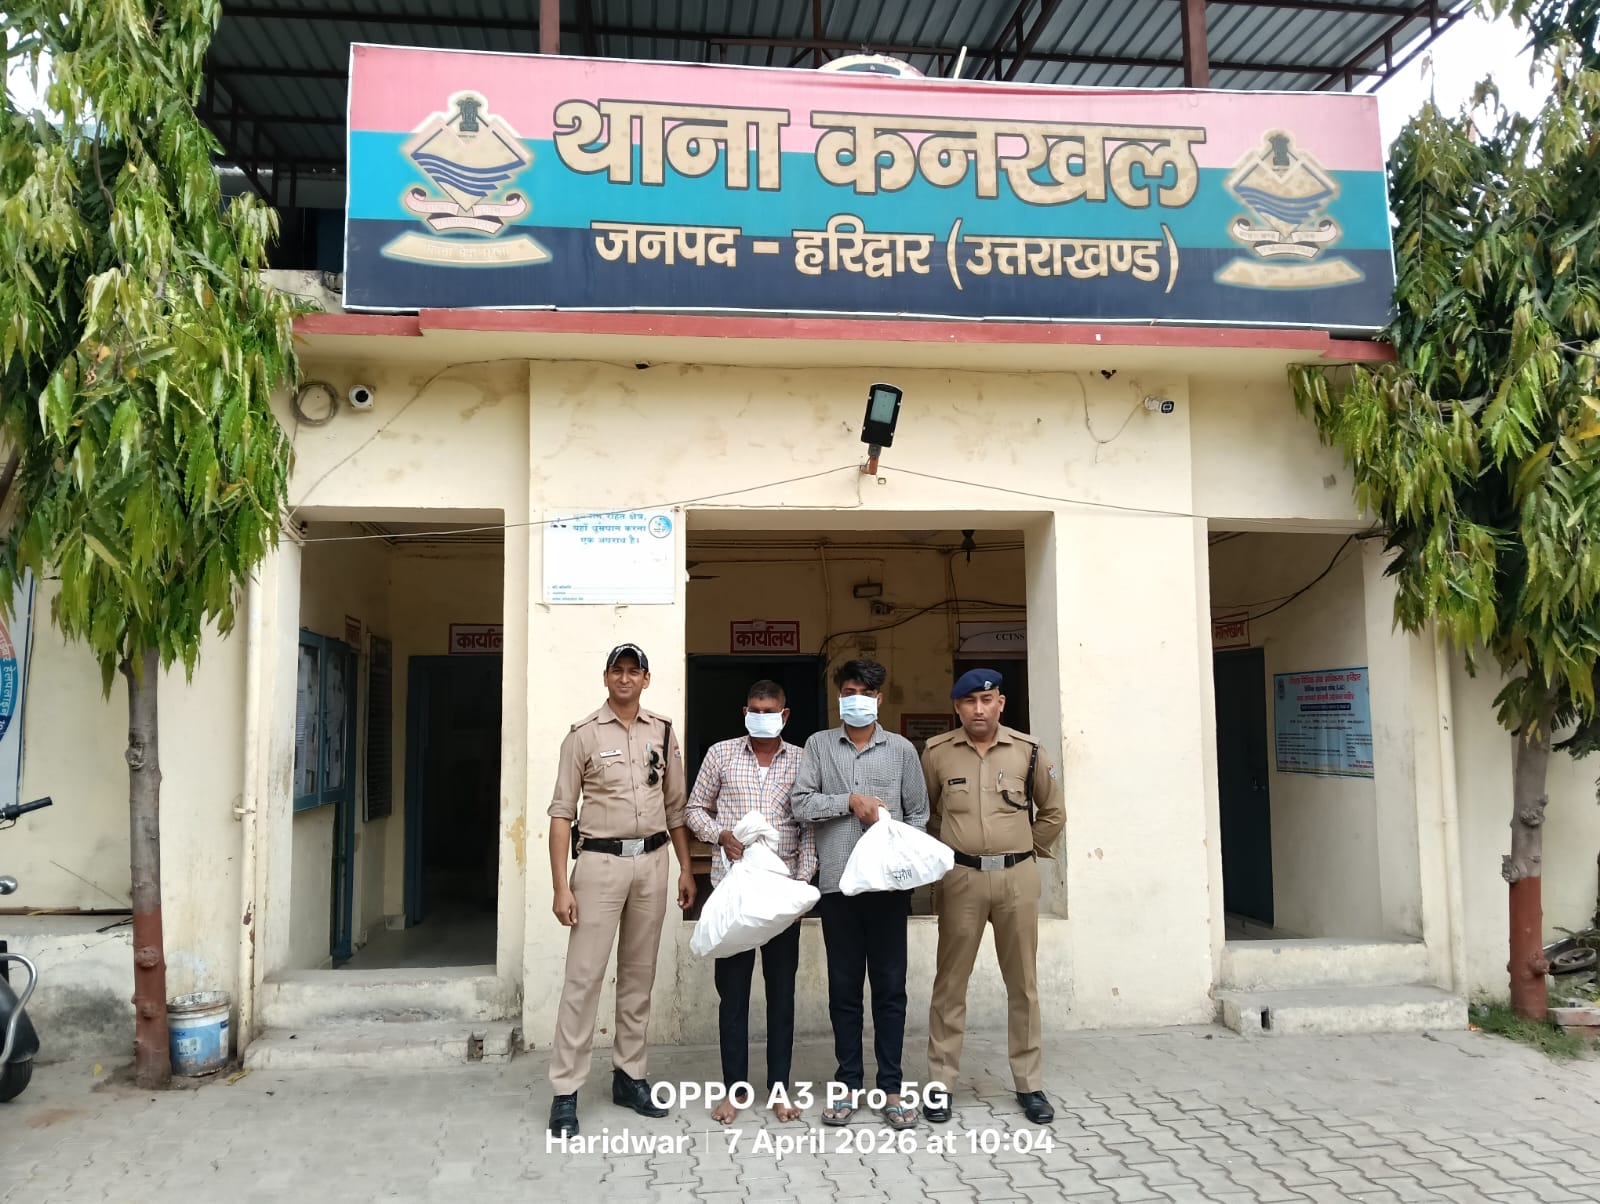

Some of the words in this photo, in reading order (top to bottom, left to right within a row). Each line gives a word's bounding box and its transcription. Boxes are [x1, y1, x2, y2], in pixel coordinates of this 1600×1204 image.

[553, 98, 790, 192] थाना
[810, 110, 1206, 209] कनखल
[590, 220, 741, 268] जनपद
[792, 212, 935, 279] हरिद्वार
[947, 217, 1179, 295] (उत्तराखण्ड)
[735, 625, 797, 647] कार्यालय
